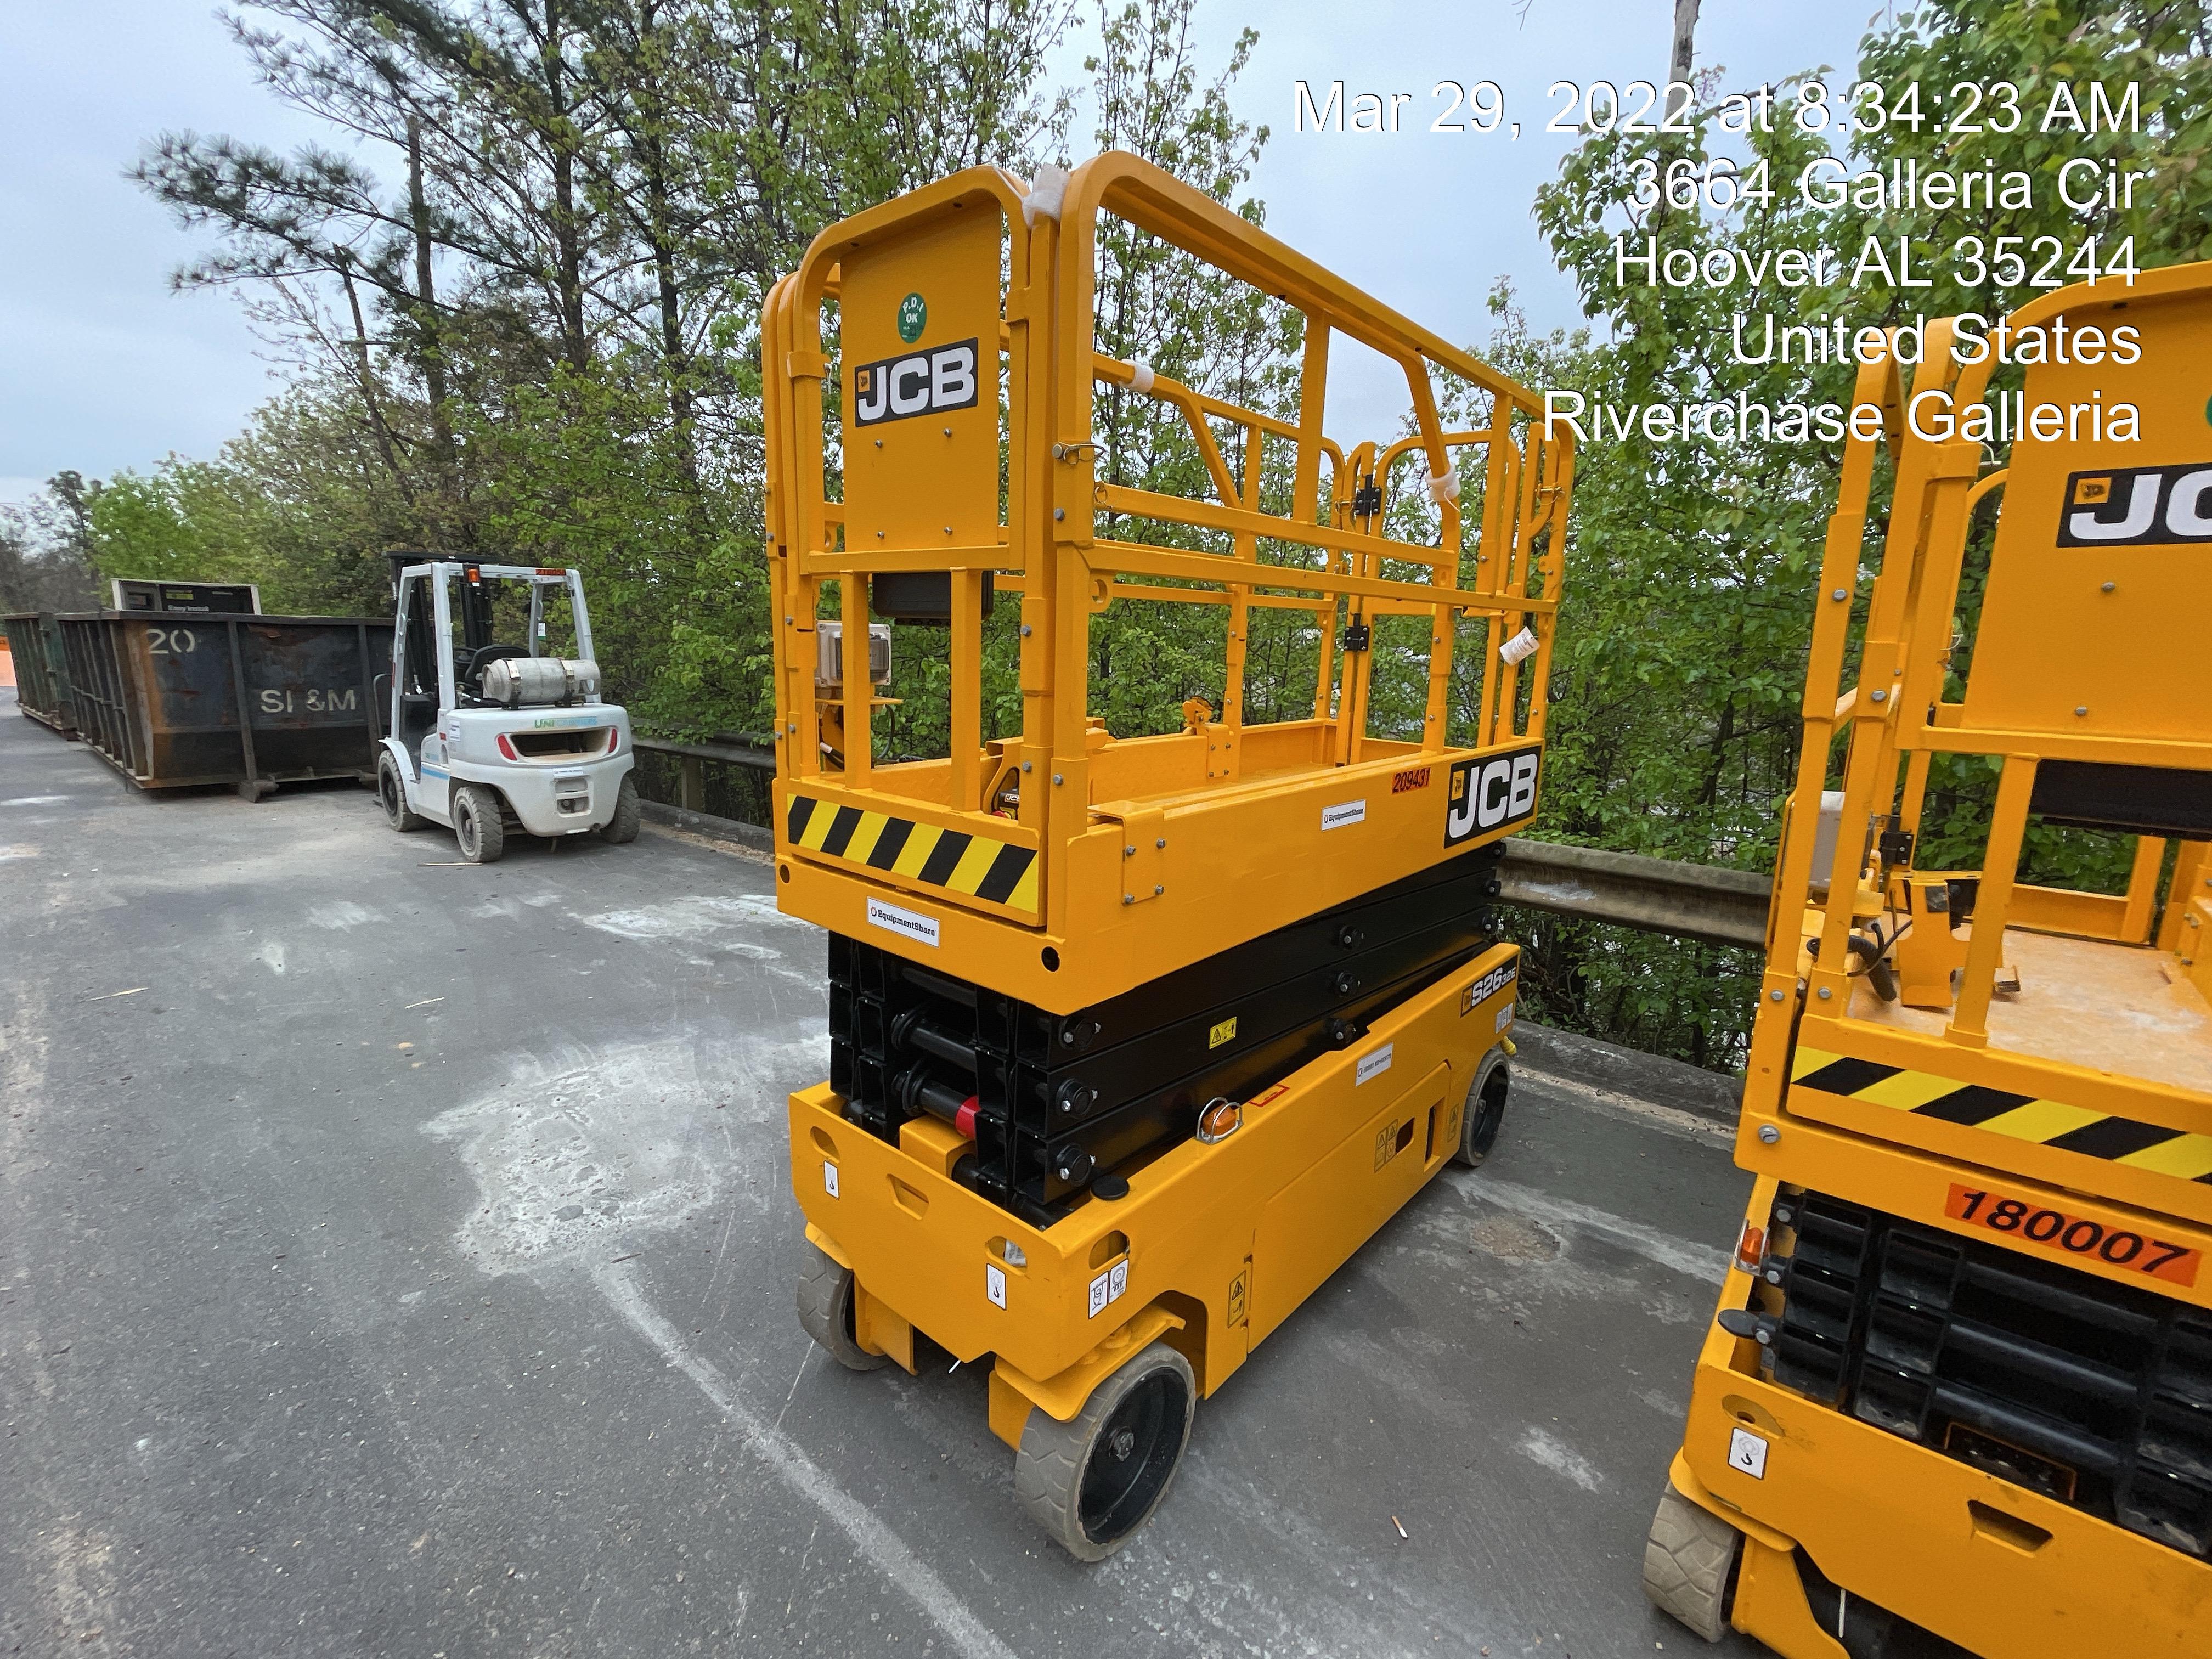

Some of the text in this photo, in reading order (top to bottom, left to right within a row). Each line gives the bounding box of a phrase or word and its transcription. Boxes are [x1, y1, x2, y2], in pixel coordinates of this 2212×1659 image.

[905, 313, 918, 323] OK
[858, 347, 974, 421] JCB
[146, 629, 195, 654] 20
[1392, 768, 1430, 793] 209431
[1448, 753, 1538, 838] JCB
[878, 909, 935, 936] EquipmentShare
[1962, 1192, 2189, 1273] 180007
